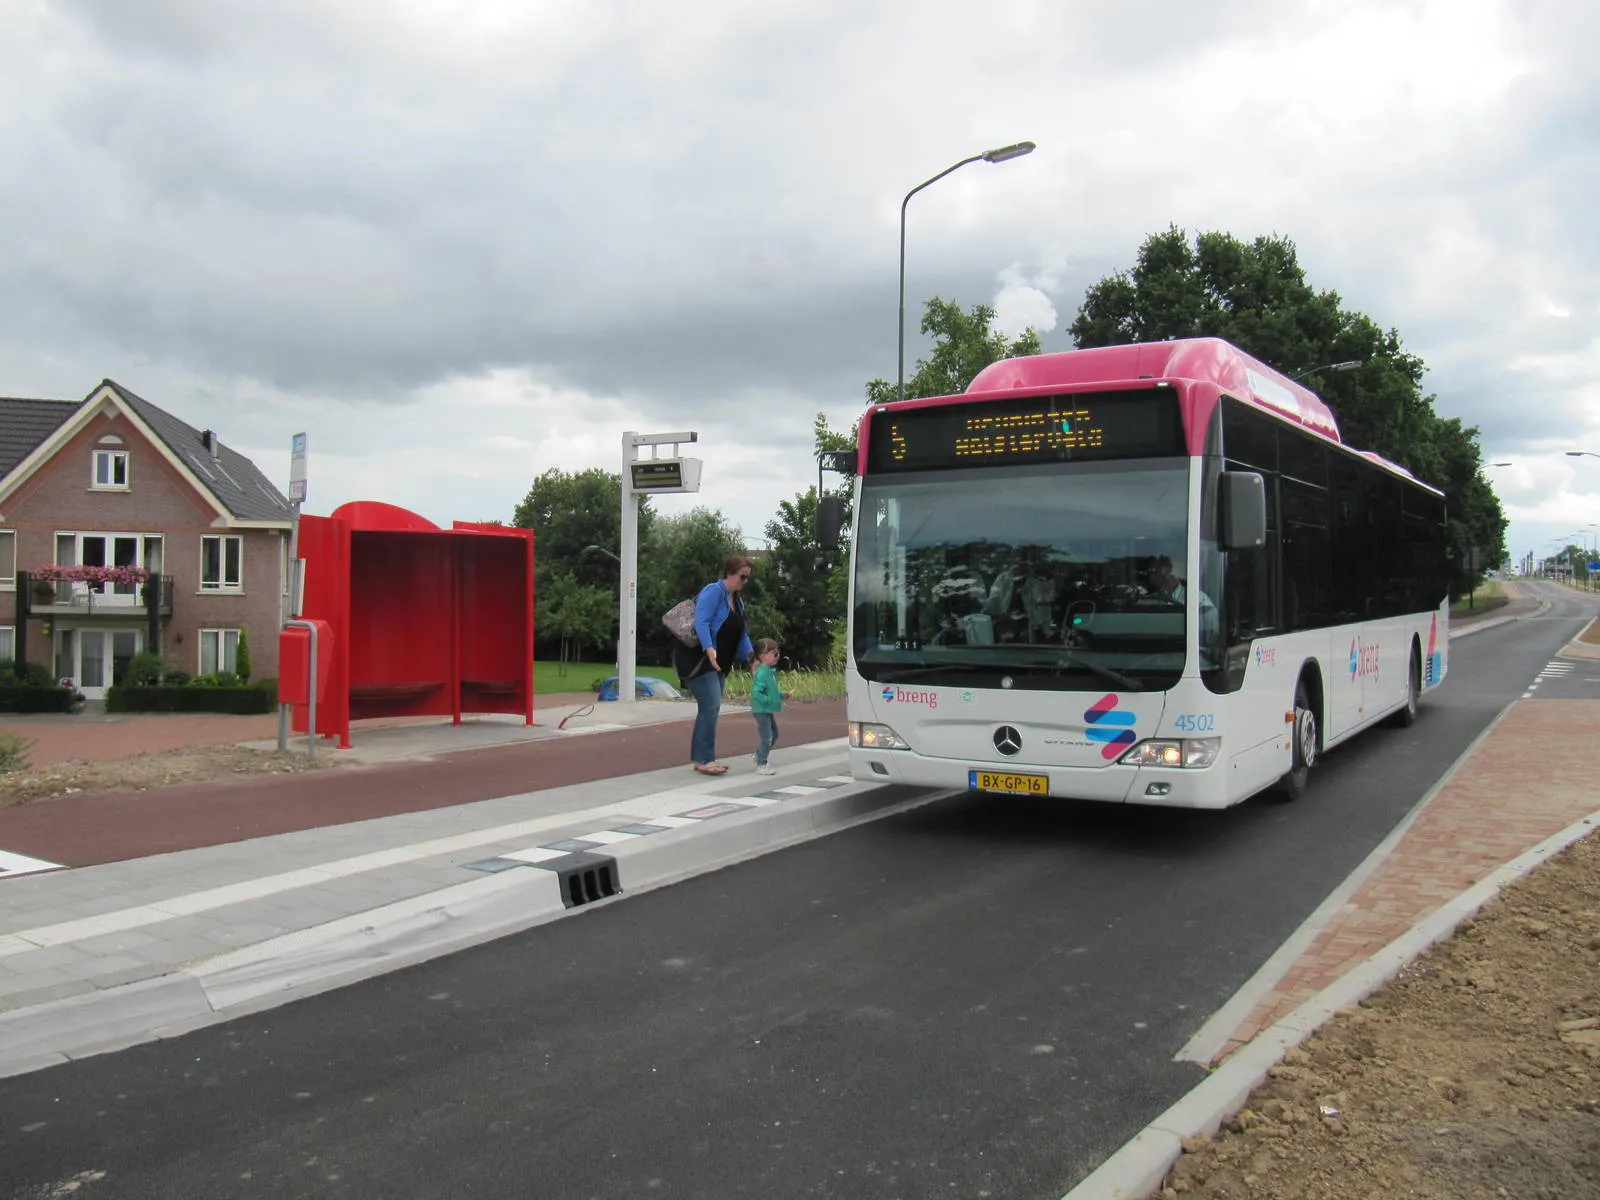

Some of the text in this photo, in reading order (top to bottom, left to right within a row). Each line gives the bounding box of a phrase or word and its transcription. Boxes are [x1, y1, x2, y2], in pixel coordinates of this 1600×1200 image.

[891, 425, 906, 459] 5
[1358, 636, 1380, 683] breng
[897, 686, 938, 708] breng
[1174, 713, 1215, 732] 4502
[983, 775, 1041, 791] BX-GP-16
